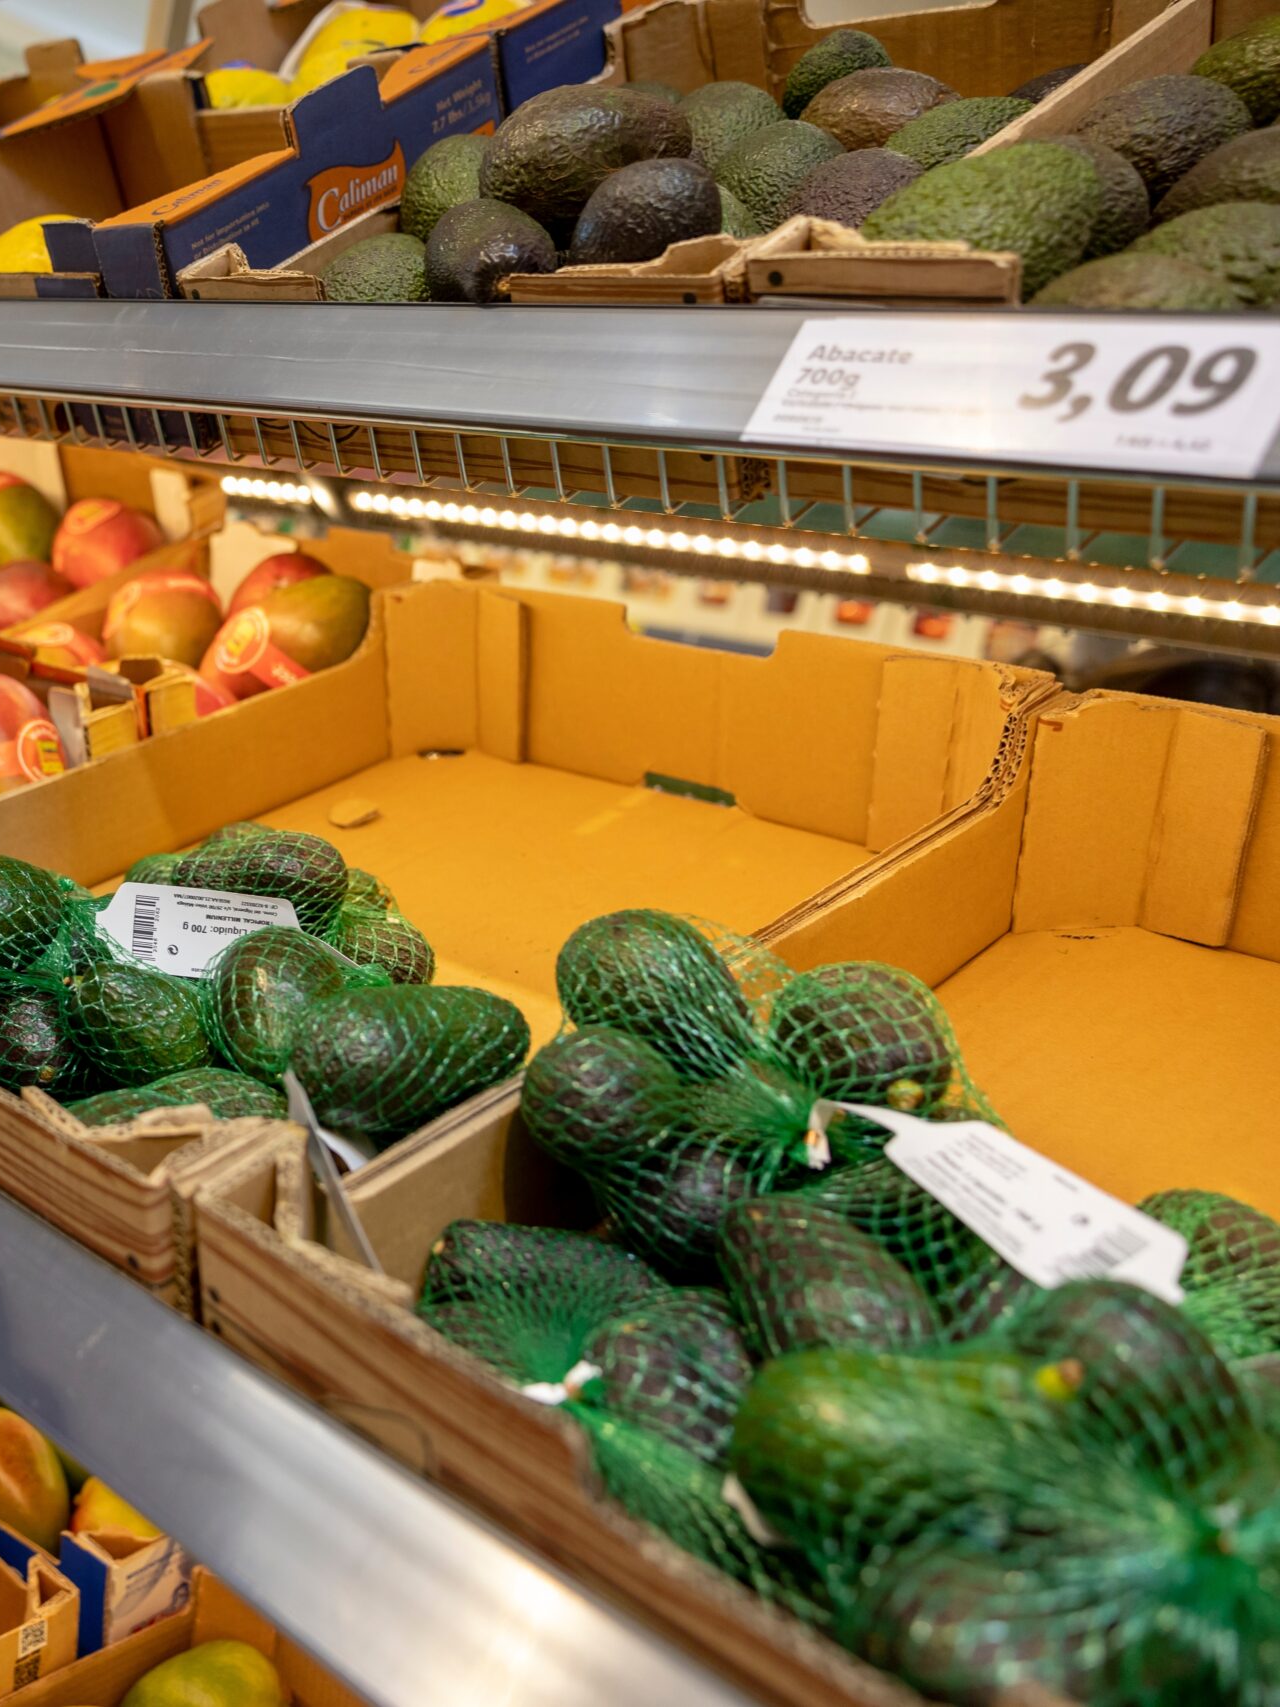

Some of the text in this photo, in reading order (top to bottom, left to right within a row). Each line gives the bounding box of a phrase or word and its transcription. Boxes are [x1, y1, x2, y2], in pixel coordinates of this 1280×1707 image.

[151, 178, 222, 217] Caliman
[317, 164, 398, 232] Caliman
[806, 344, 913, 365] Abacate
[794, 367, 861, 391] 700g
[1018, 341, 1260, 423] 3,09
[182, 921, 189, 930] g
[191, 924, 208, 934] 700
